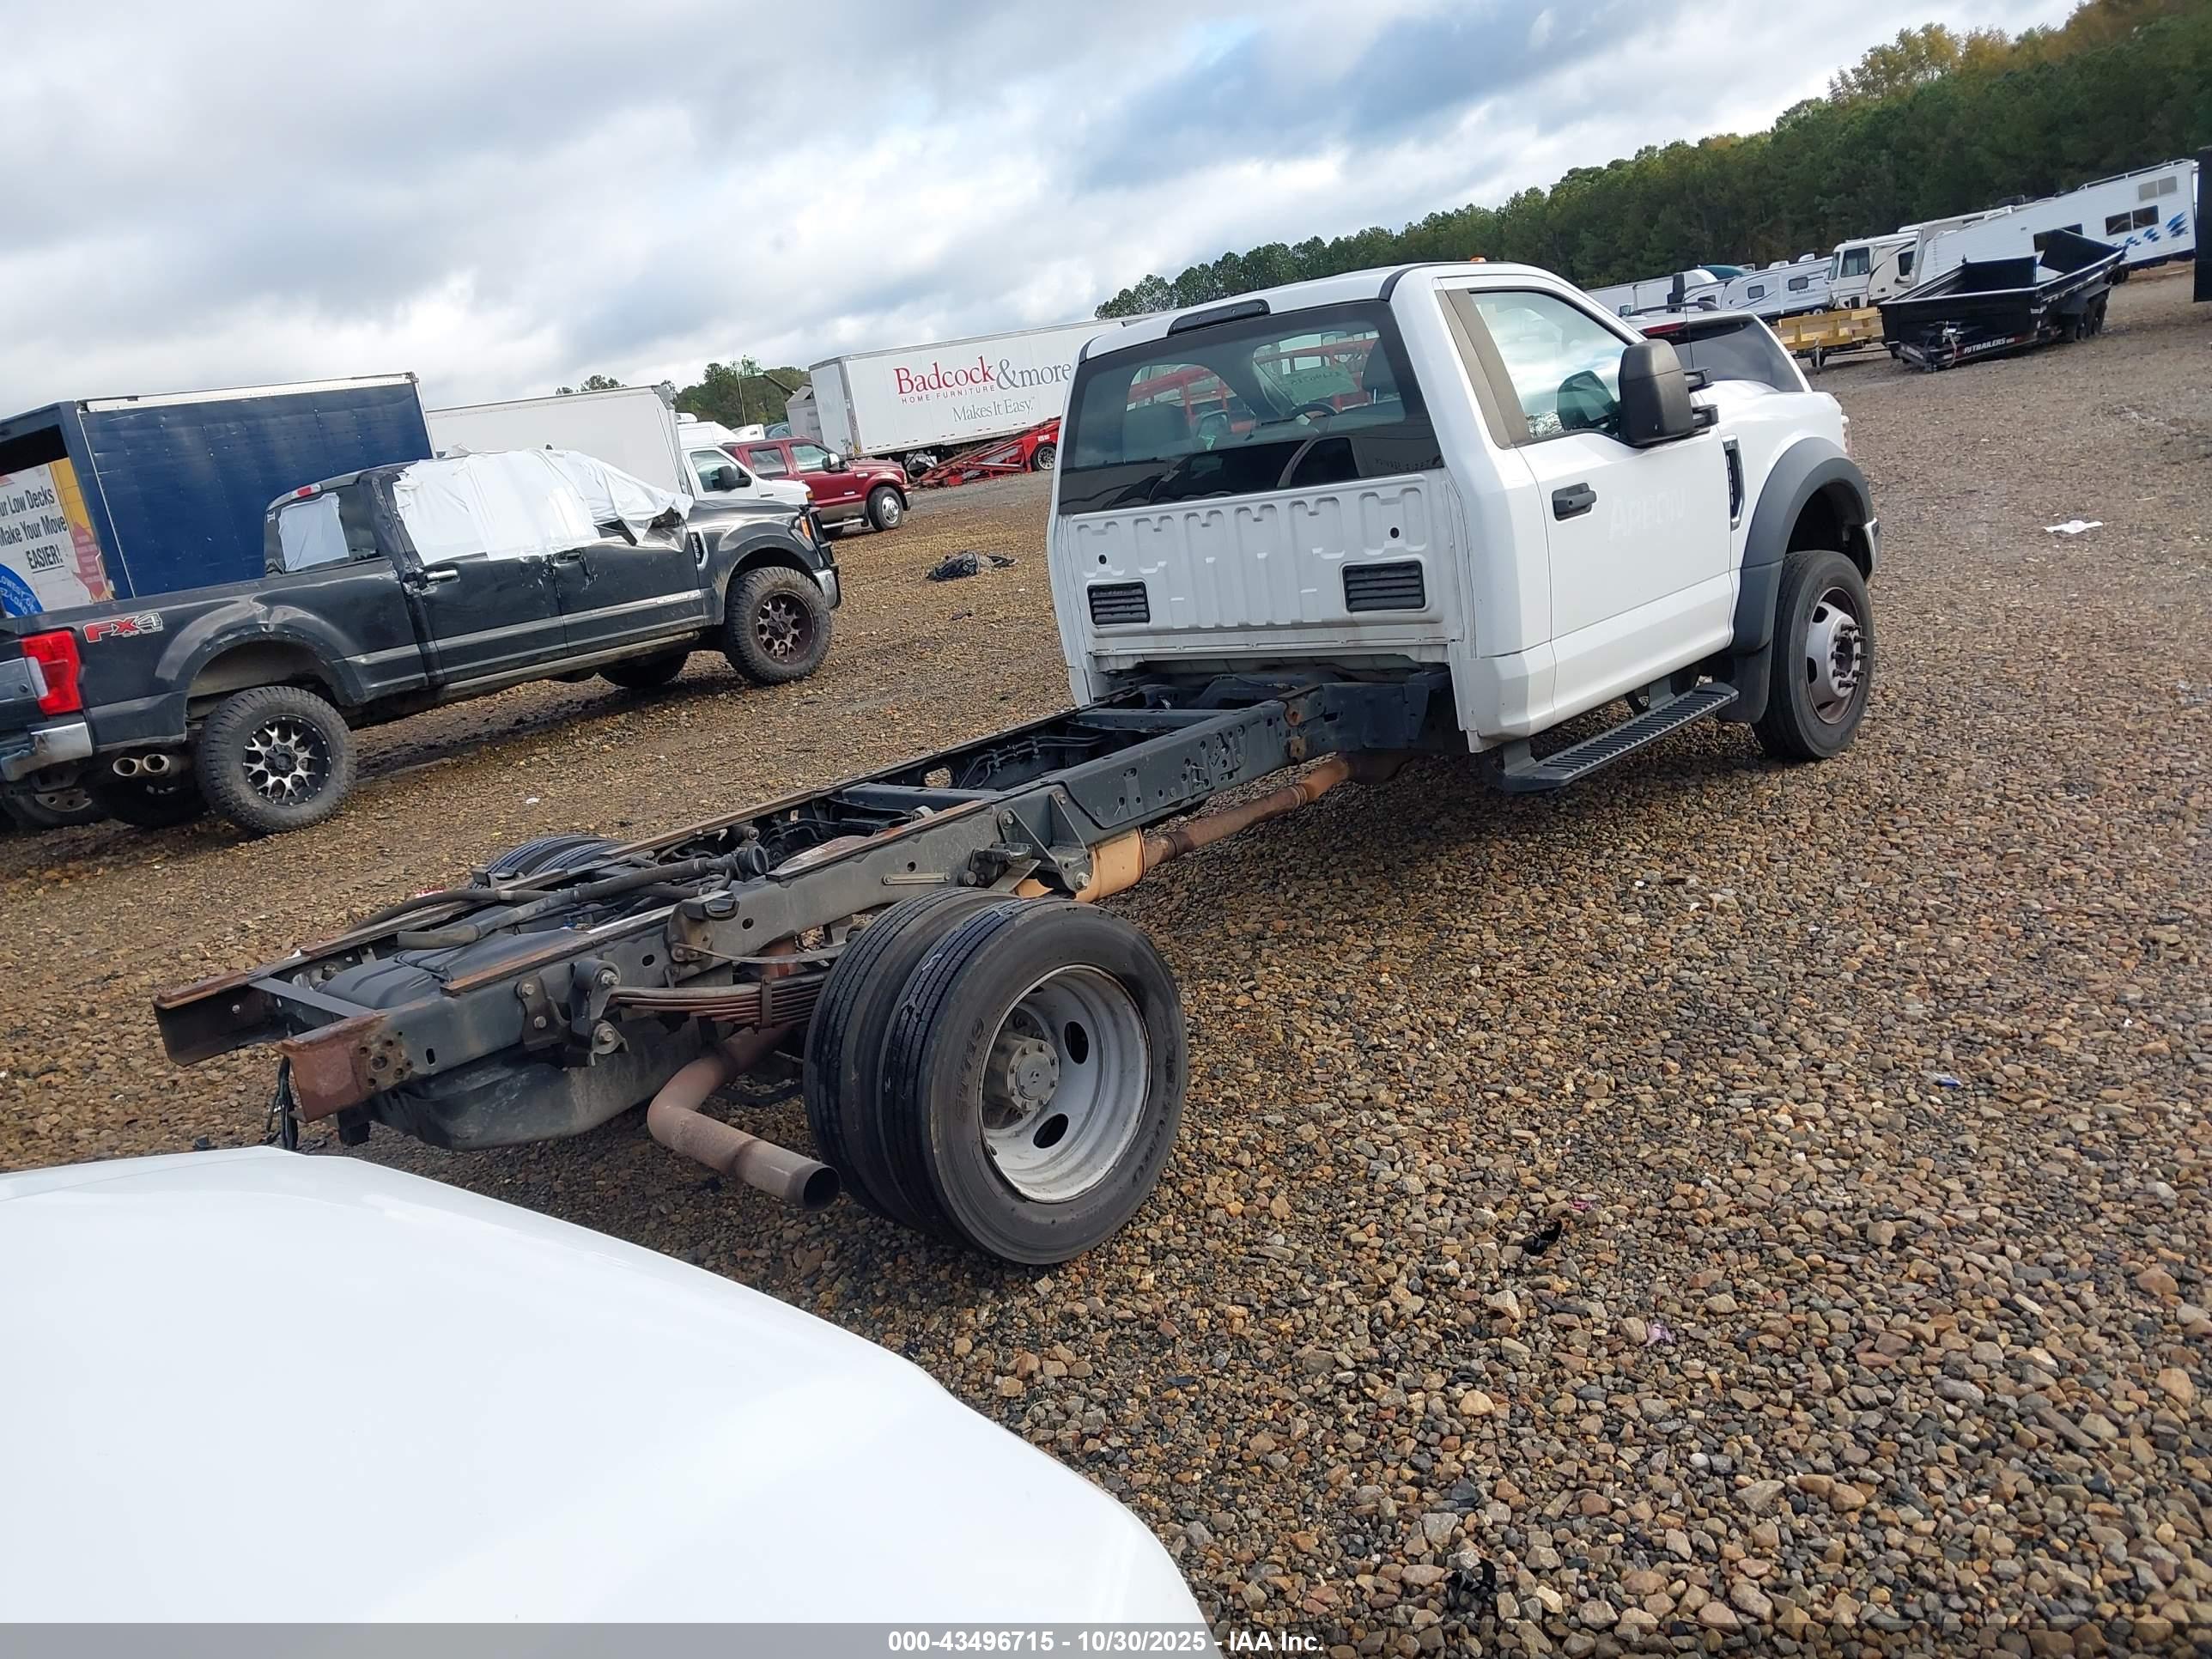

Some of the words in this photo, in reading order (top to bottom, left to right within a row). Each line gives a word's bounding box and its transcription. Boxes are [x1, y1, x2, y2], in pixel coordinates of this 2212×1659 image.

[901, 392, 932, 405] HOME
[935, 384, 996, 399] FURNITURE
[951, 404, 992, 423] Makes
[993, 400, 1003, 416] It
[7, 495, 27, 514] Low
[25, 485, 56, 509] Decks
[0, 524, 23, 547] Make
[21, 519, 45, 541] Your
[40, 515, 68, 536] Move
[26, 543, 64, 570] EASIER!
[82, 611, 164, 644] FX4
